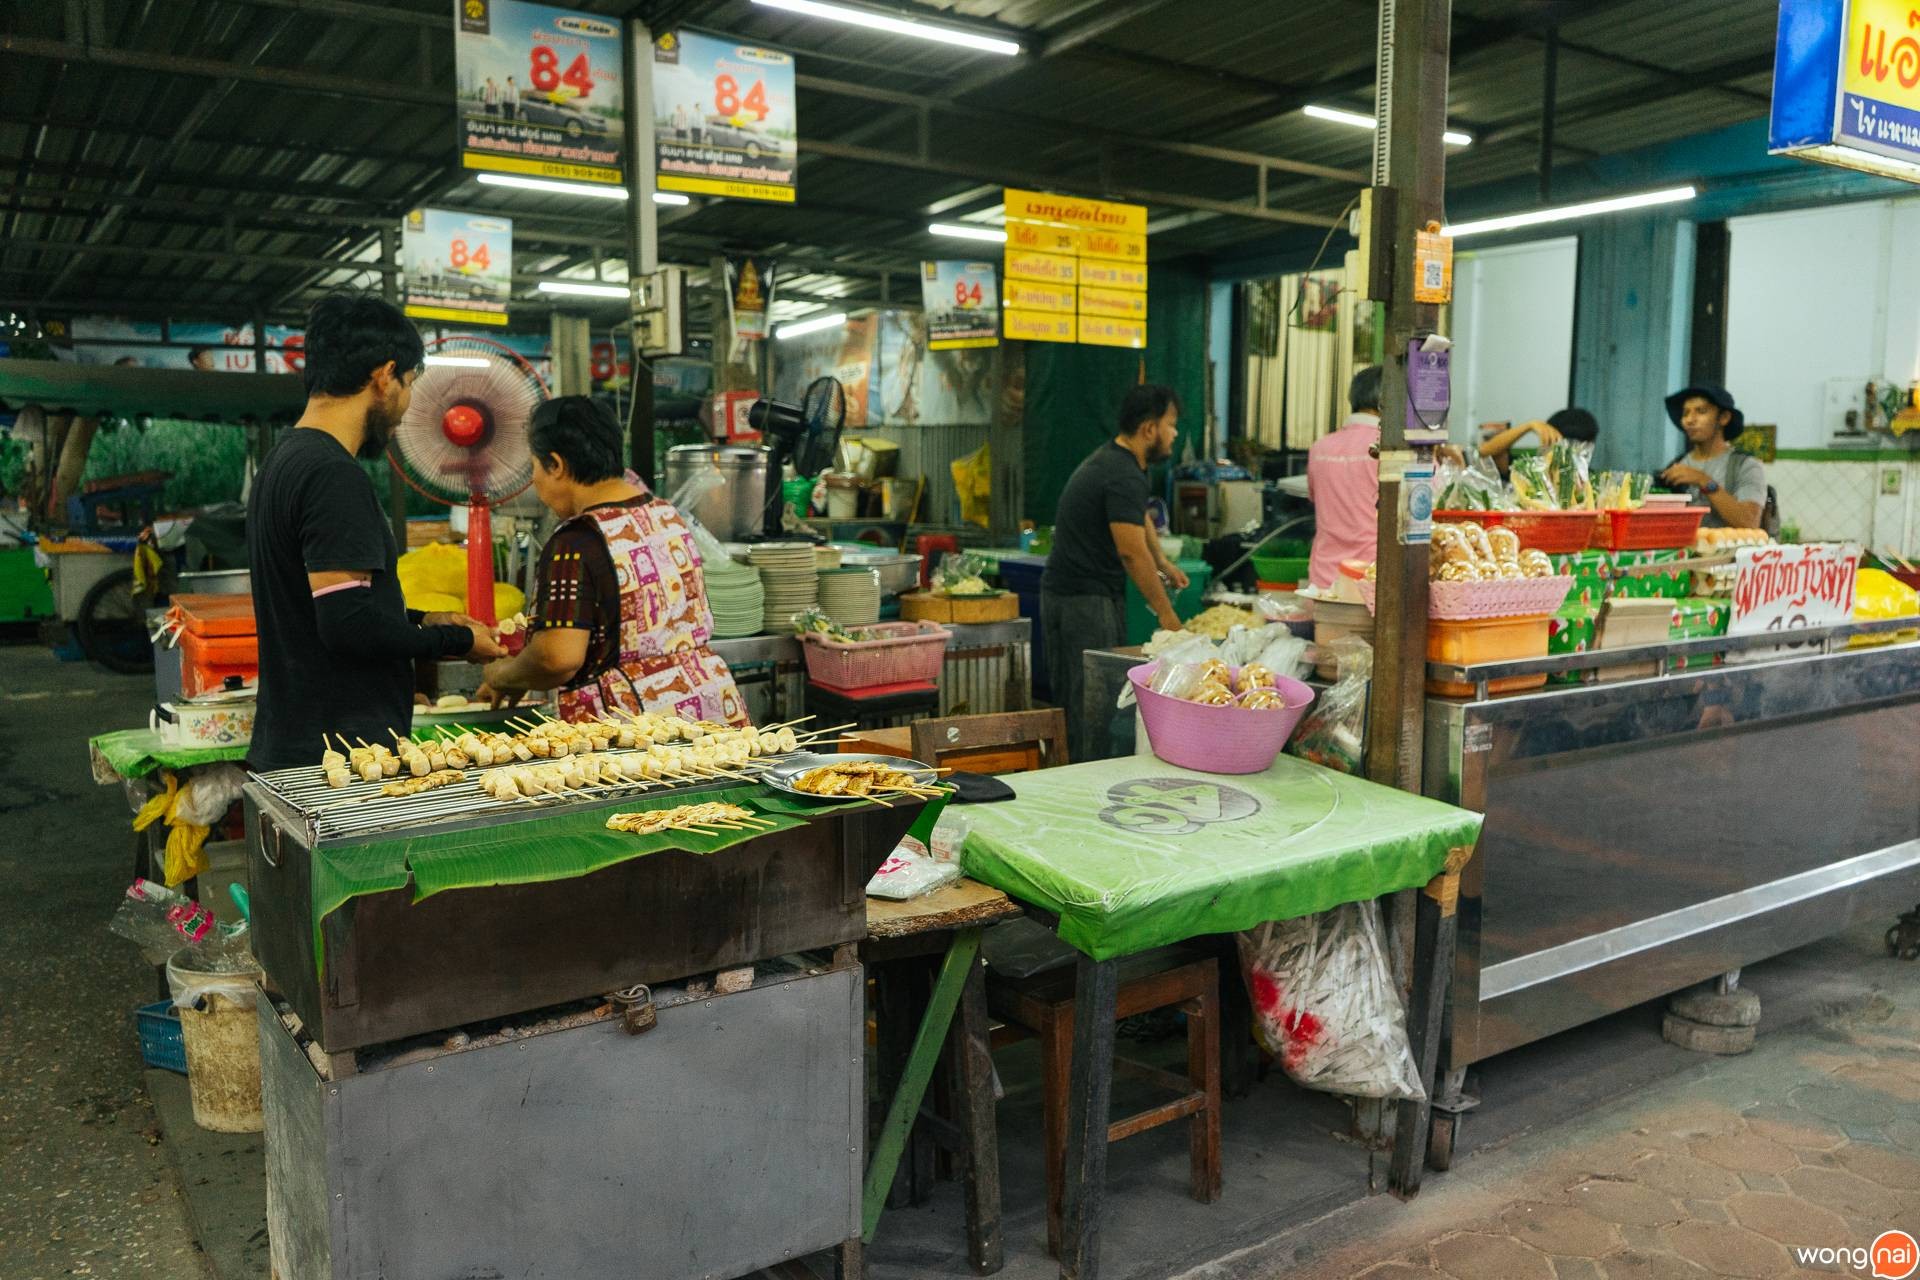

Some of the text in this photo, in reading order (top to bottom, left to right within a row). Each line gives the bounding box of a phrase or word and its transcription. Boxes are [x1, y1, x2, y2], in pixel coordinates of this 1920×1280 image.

[530, 46, 595, 97] 84
[715, 73, 770, 121] 84
[450, 239, 490, 270] 84
[955, 281, 984, 305] 84
